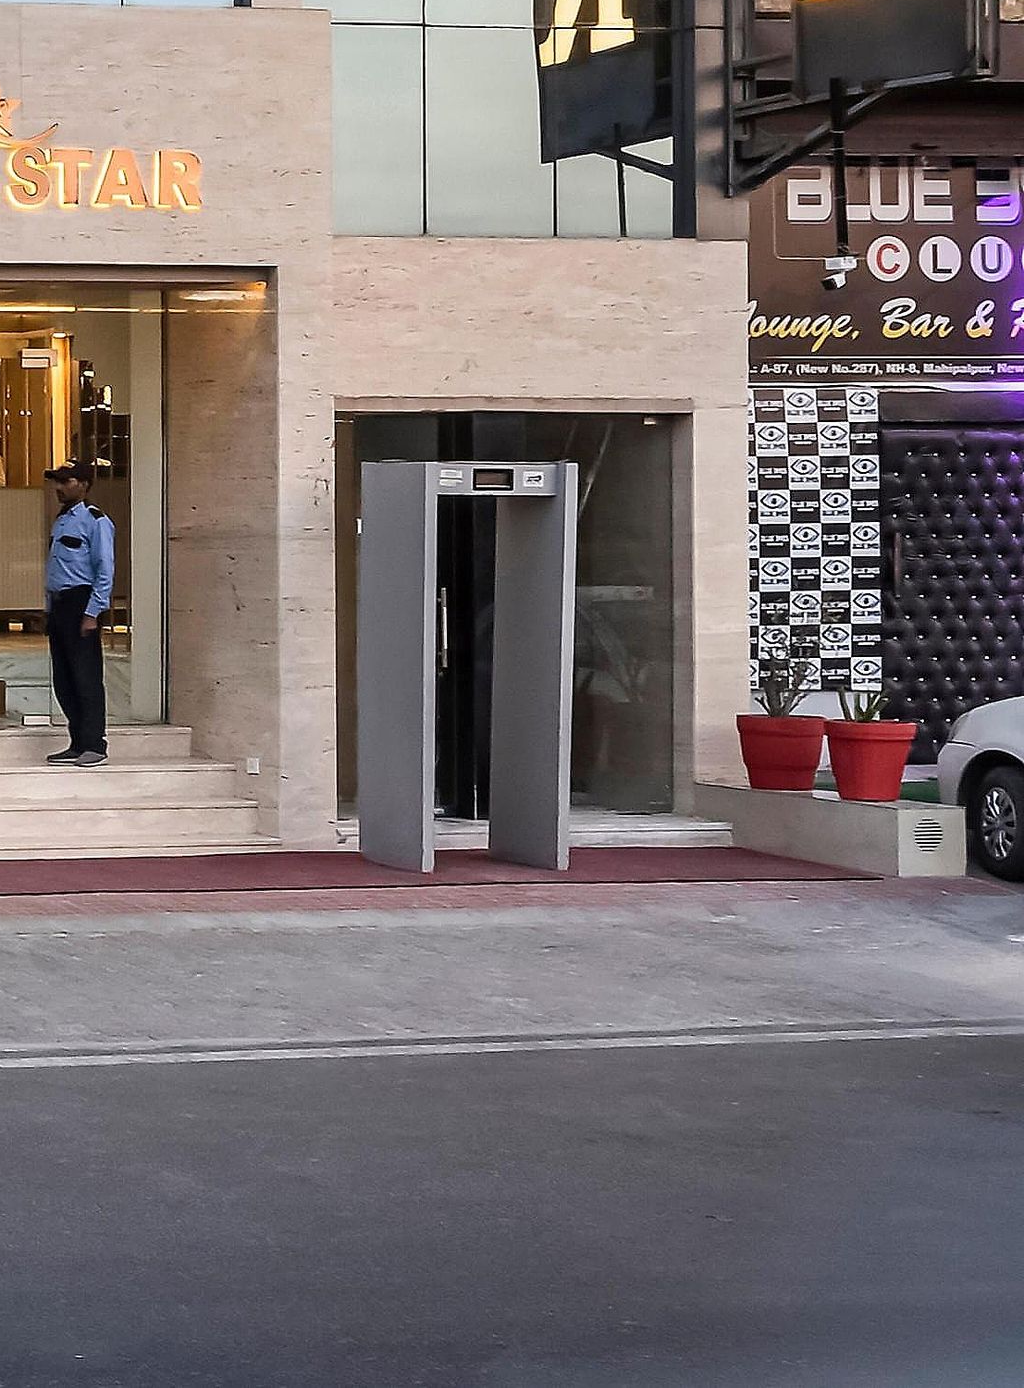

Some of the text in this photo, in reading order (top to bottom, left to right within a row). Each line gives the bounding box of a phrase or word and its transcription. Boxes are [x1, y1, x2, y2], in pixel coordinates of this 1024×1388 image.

[5, 145, 205, 212] STAR
[879, 297, 955, 339] Bar
[966, 299, 996, 339] &
